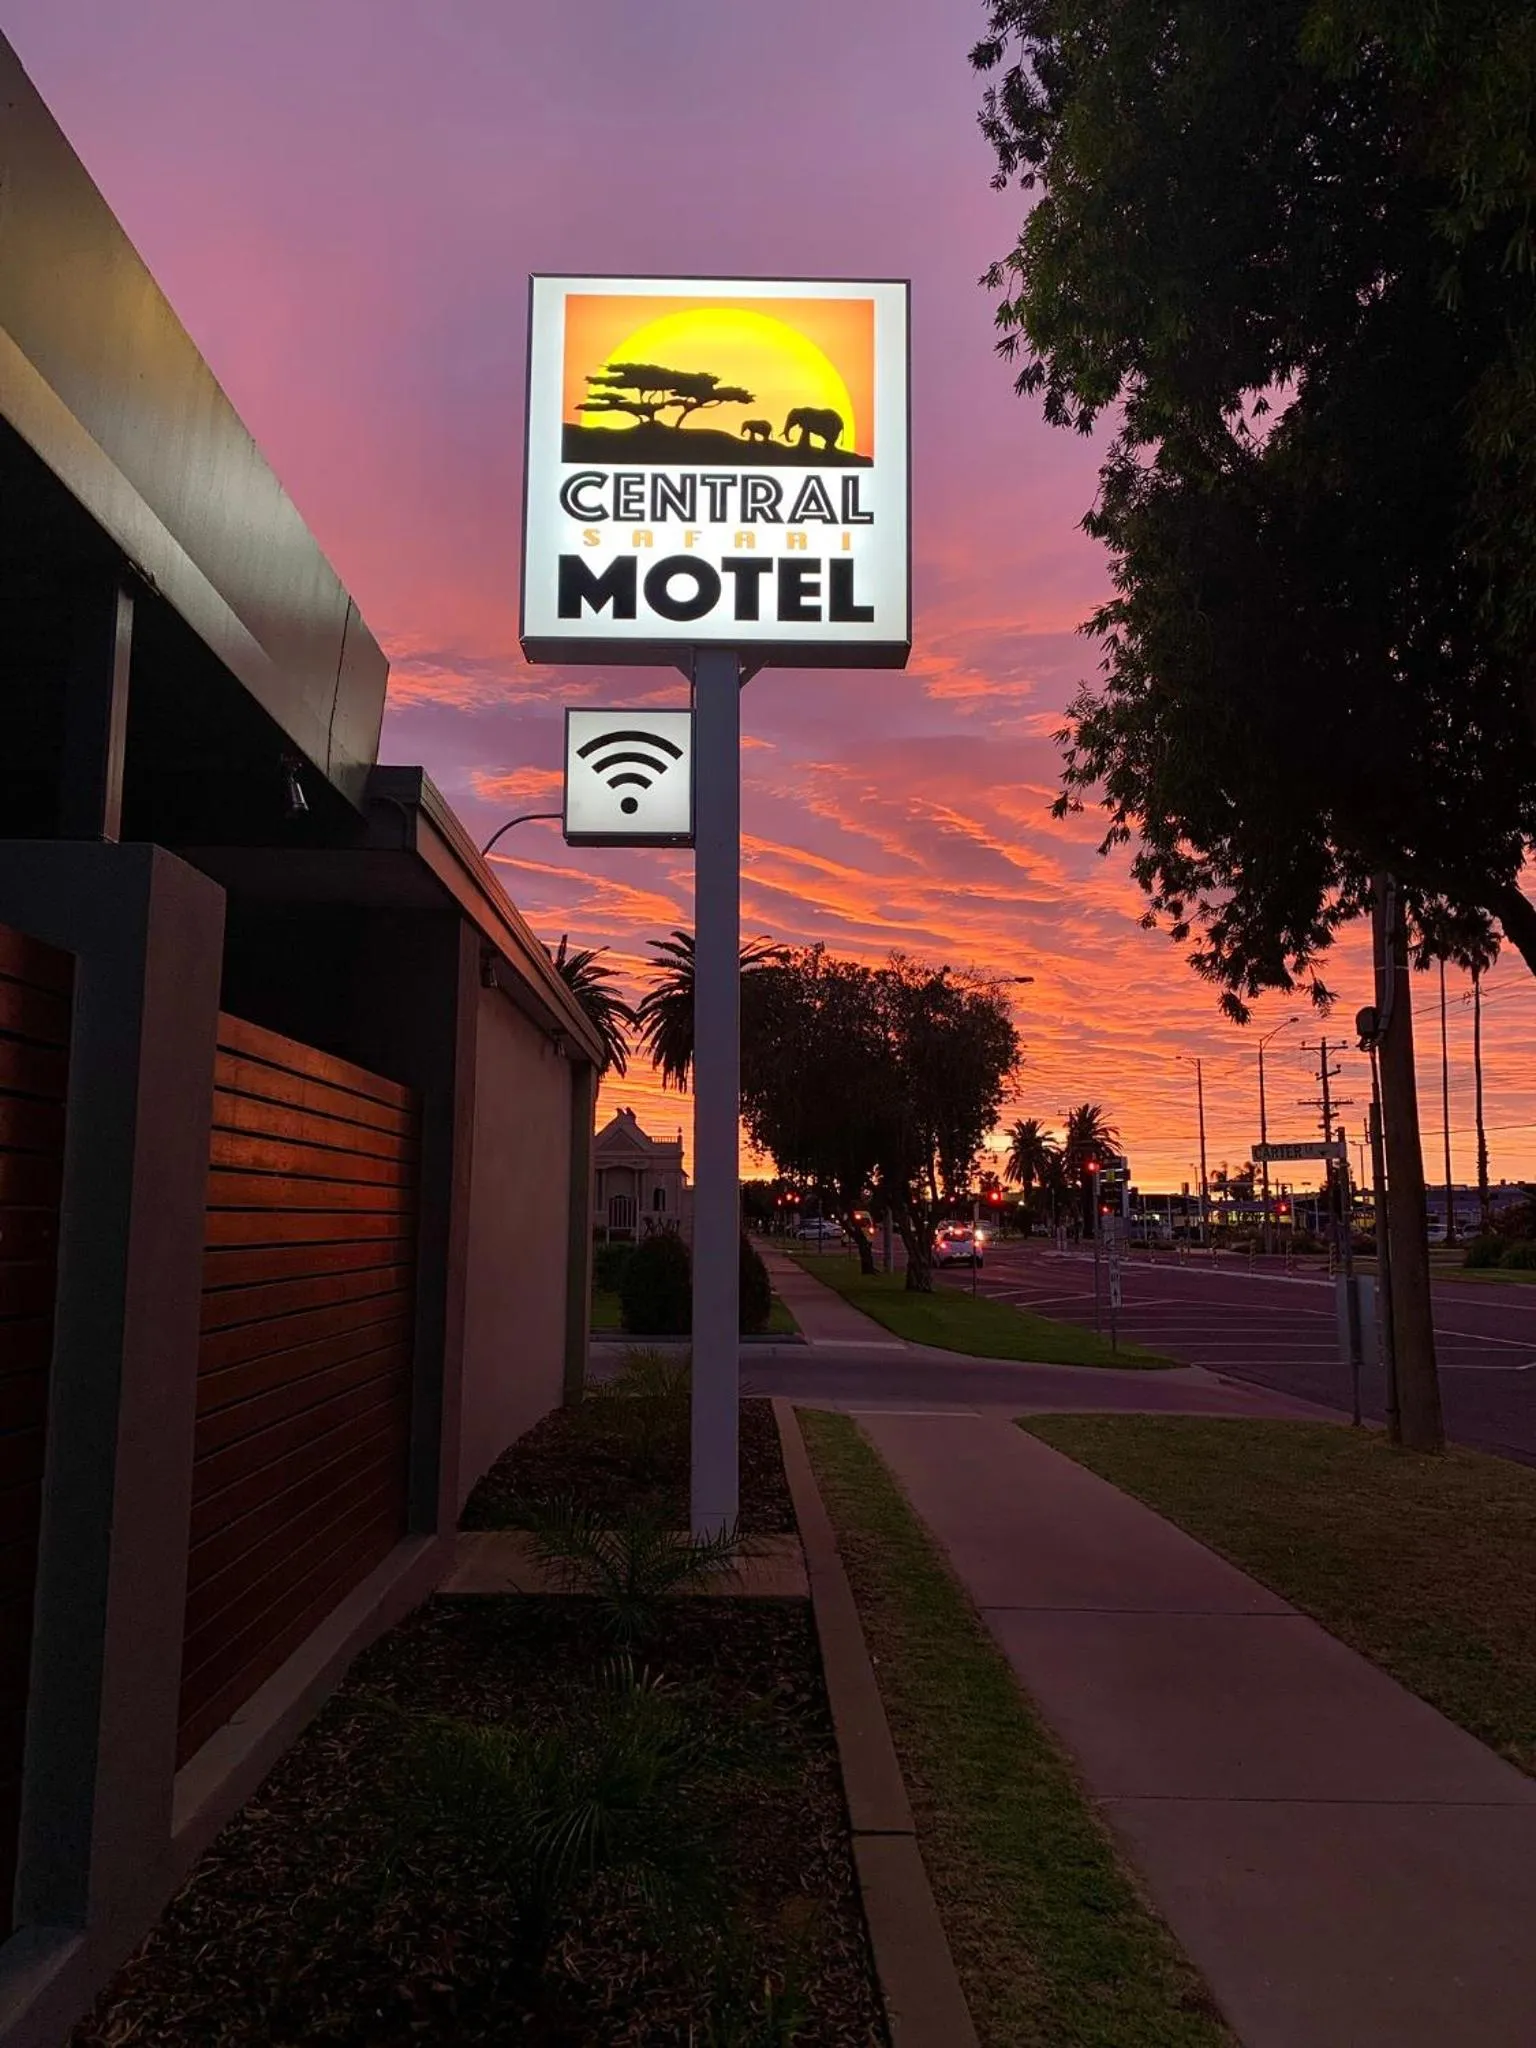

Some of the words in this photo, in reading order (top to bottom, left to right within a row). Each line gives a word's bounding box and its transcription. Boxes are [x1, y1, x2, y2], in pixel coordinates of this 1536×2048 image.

[560, 471, 875, 525] CENTRAL
[583, 528, 852, 551] SAFARI
[558, 554, 875, 623] MOTEL
